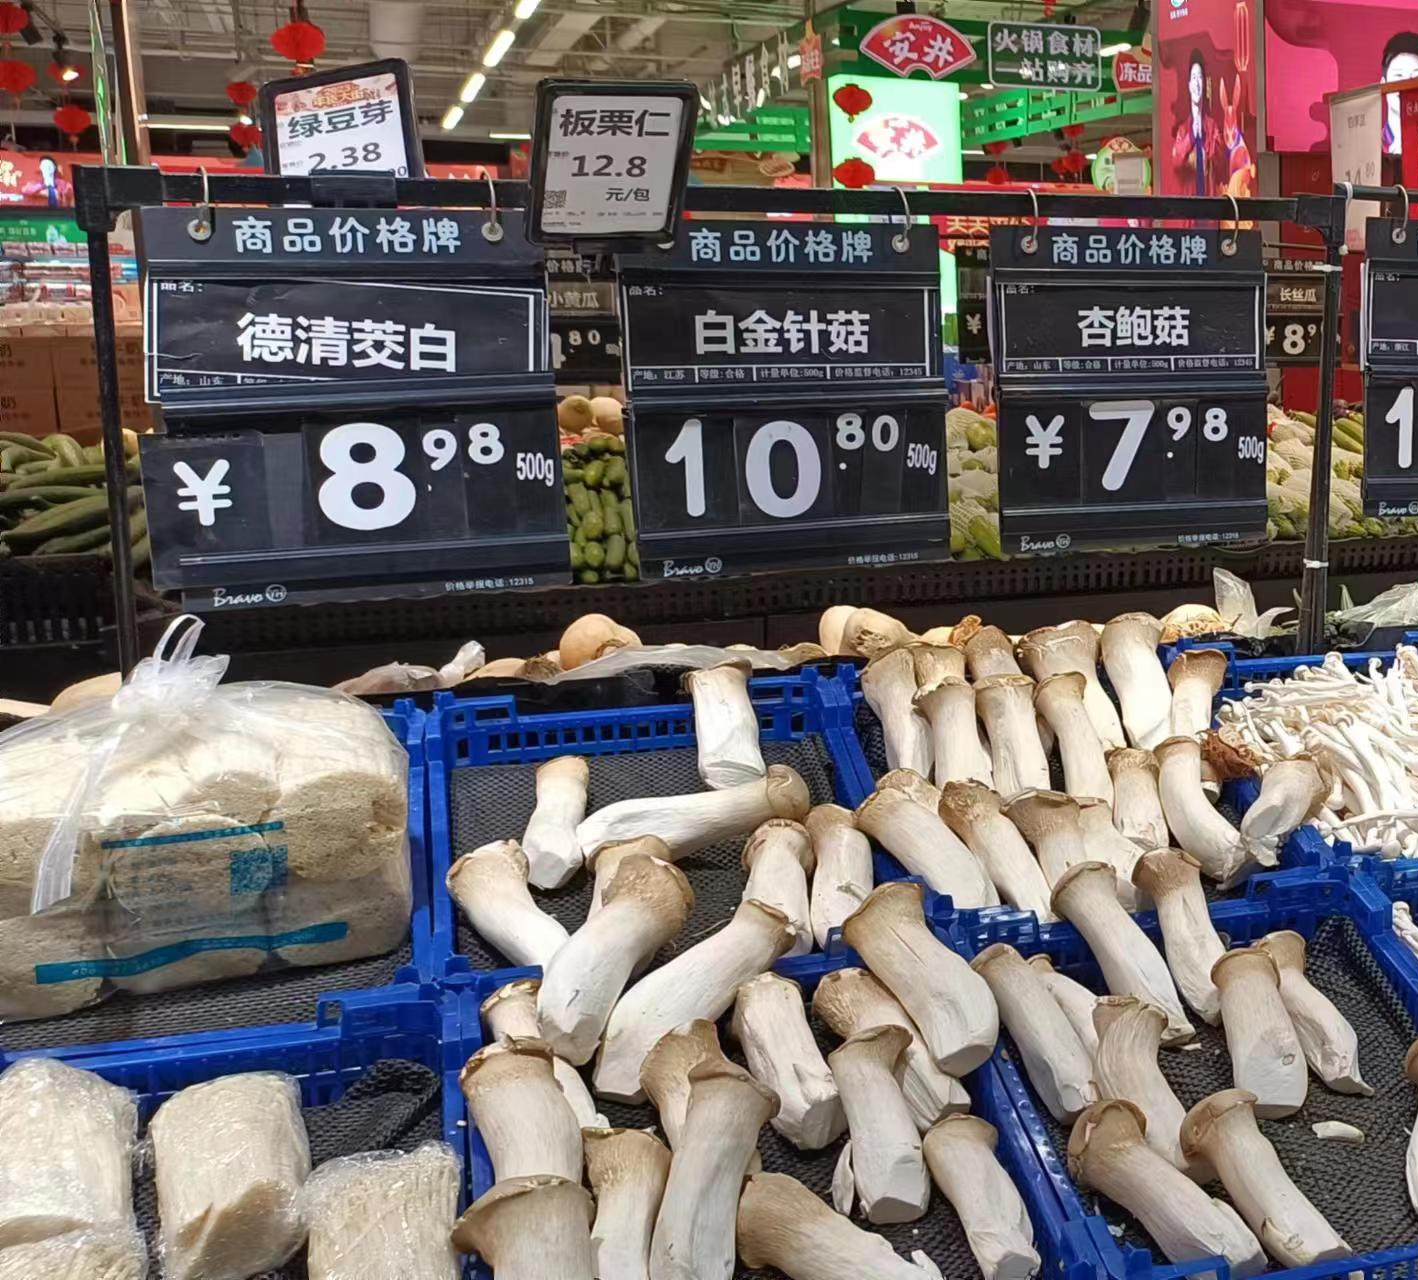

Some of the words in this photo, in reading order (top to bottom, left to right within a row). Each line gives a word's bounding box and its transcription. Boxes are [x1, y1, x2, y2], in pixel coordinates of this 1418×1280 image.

[883, 32, 954, 68] 安井
[995, 28, 1096, 57] 火锅食材
[995, 58, 1095, 85] 一站购齐
[1119, 62, 1152, 82] 冻品
[288, 100, 393, 139] 绿豆芽
[560, 108, 671, 137] 板栗仁
[308, 143, 381, 170] 2.38
[571, 155, 647, 177] 12.8
[606, 188, 650, 201] 元/包
[232, 217, 462, 254] 商品价格牌
[689, 227, 874, 264] 商品价格牌
[1052, 232, 1208, 265] 商品价格牌
[548, 291, 599, 308] 小黄瓜
[1280, 287, 1317, 302] 长丝瓜
[694, 310, 870, 354] 白金针菇
[1077, 306, 1190, 348] 杏鲍菇
[237, 312, 457, 373] 德清茭白
[1025, 414, 1065, 469] ¥
[1238, 436, 1264, 464] 500g
[907, 443, 937, 475] 500g
[173, 459, 232, 526] ¥
[516, 452, 554, 486] 500g
[1378, 502, 1407, 516] Bravo
[1020, 536, 1055, 551] Bravo
[663, 560, 704, 578] Bravo
[213, 587, 263, 608] Bravo
